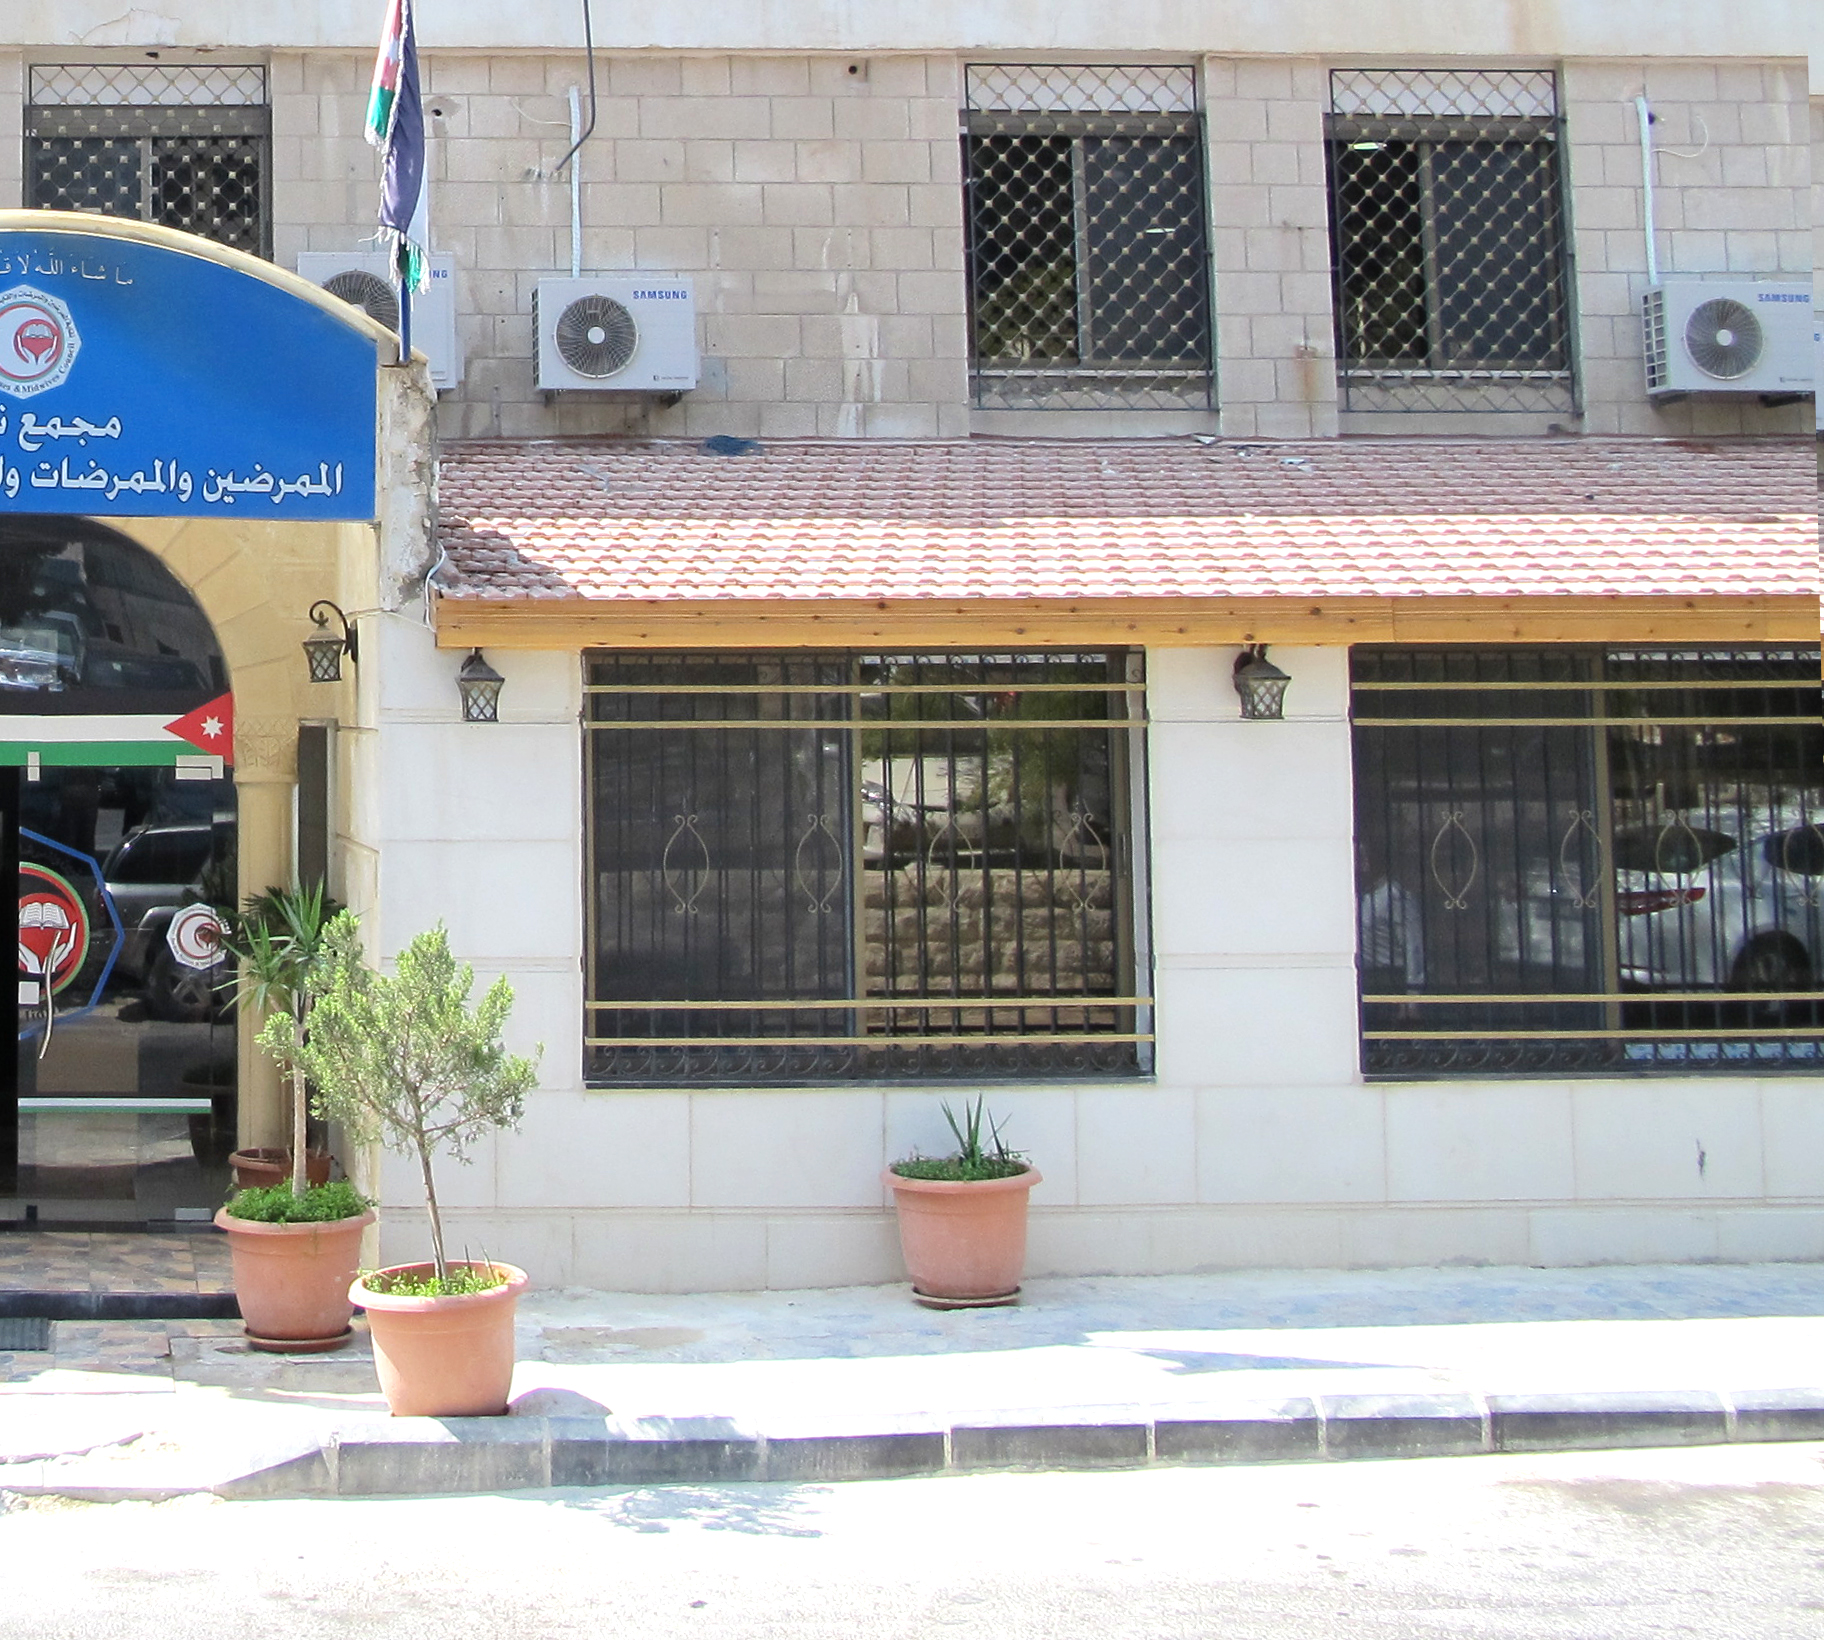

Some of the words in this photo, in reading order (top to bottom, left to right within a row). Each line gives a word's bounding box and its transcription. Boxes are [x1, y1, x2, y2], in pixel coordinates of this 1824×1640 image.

[633, 290, 688, 299] SAMSUNG
[1758, 293, 1810, 303] SAMSUNG
[59, 343, 75, 375] Council
[18, 411, 122, 451] مجمع
[29, 455, 194, 502] والممرضات
[202, 460, 343, 504] الممرضين
